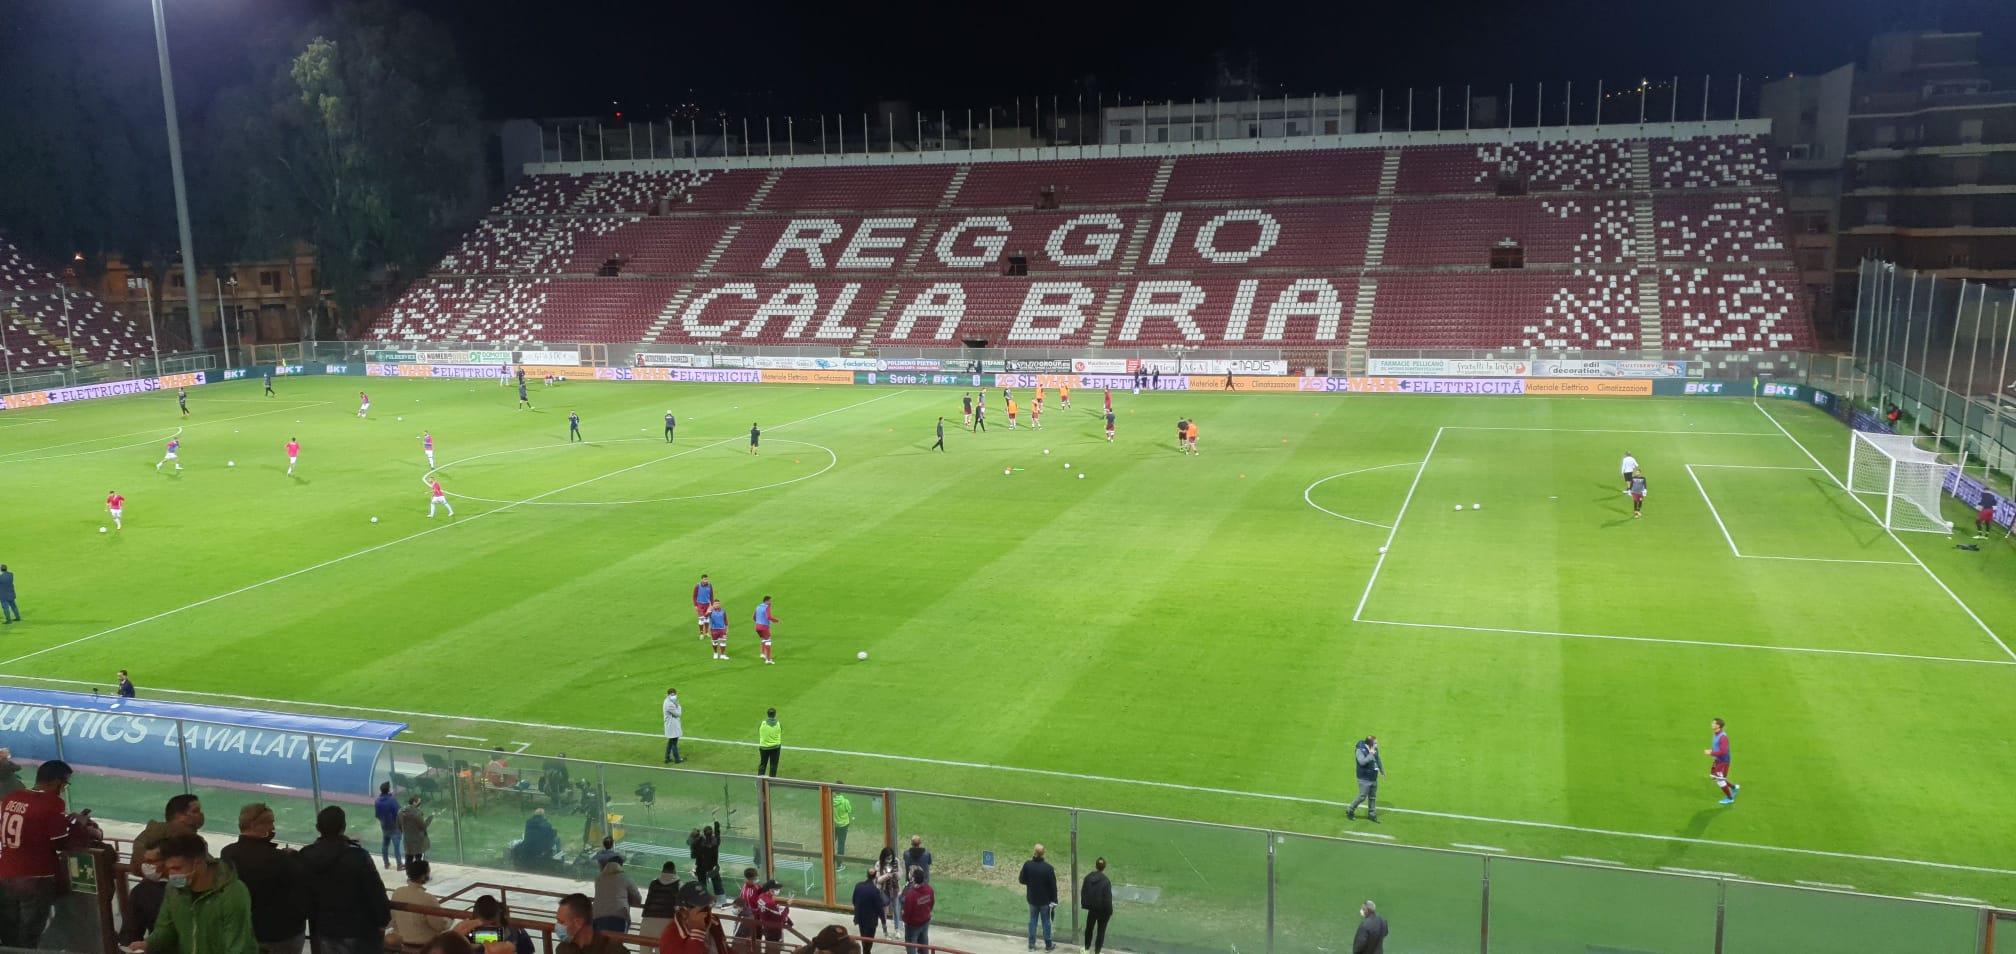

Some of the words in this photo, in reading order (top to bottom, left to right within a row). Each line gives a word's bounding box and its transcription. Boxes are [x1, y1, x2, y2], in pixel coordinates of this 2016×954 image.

[760, 209, 1281, 268] REGGIO
[681, 279, 1342, 341] CALABRIA
[224, 370, 246, 379] BKT
[326, 365, 347, 373] BKT
[889, 374, 917, 384] Serie
[933, 376, 958, 384] BKT
[1561, 383, 1589, 391] Elettrico
[1597, 383, 1648, 392] Climatizzazione
[1685, 383, 1723, 393] BKT
[1763, 384, 1797, 395] BKT
[163, 723, 199, 748] LA
[204, 726, 246, 753] VIA
[250, 731, 354, 765] LATTEA
[5, 800, 29, 814] DENIS
[2, 811, 24, 848] 19
